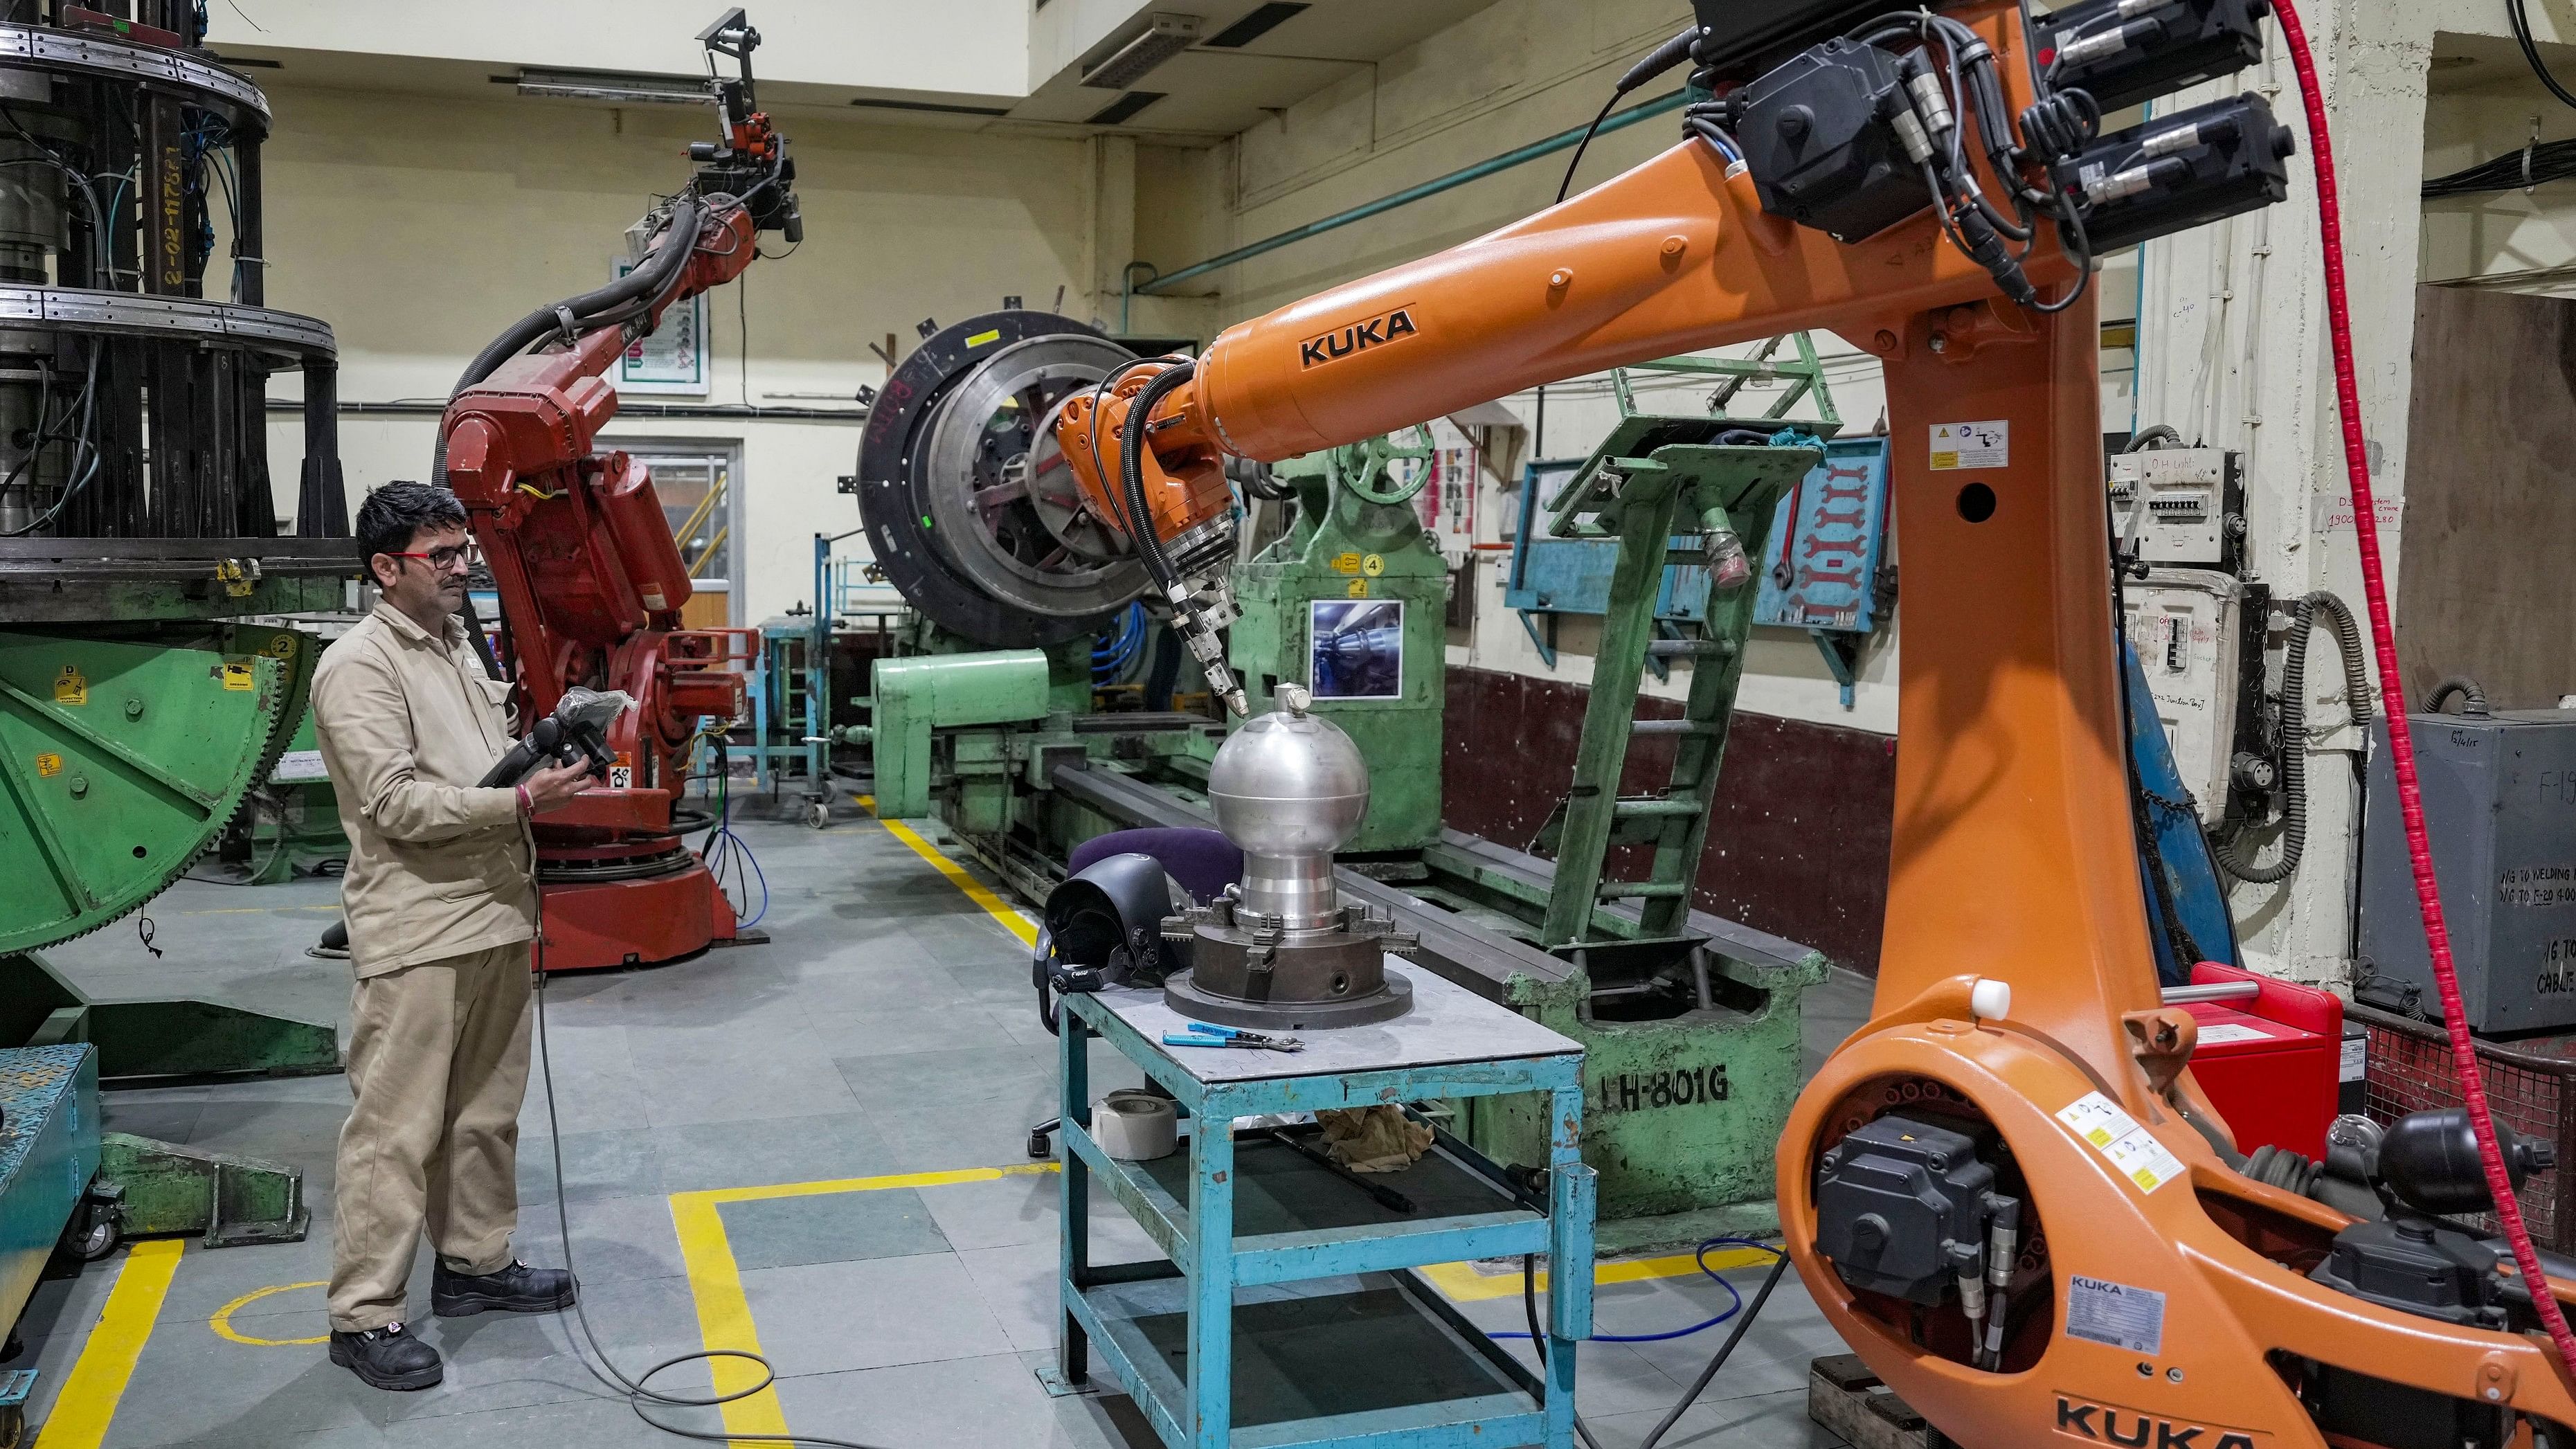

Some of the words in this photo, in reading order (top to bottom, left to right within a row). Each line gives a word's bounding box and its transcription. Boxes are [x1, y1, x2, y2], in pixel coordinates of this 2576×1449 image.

[1301, 309, 1416, 366] KUKA
[1369, 559, 1377, 570] 4
[278, 641, 289, 653] 2
[66, 665, 75, 674] D
[2532, 868, 2570, 881] WELDING
[2519, 889, 2529, 903] TO
[2537, 971, 2575, 995] CABLE
[2072, 1277, 2123, 1295] KUKA
[2057, 1396, 2255, 1449] KUKA
